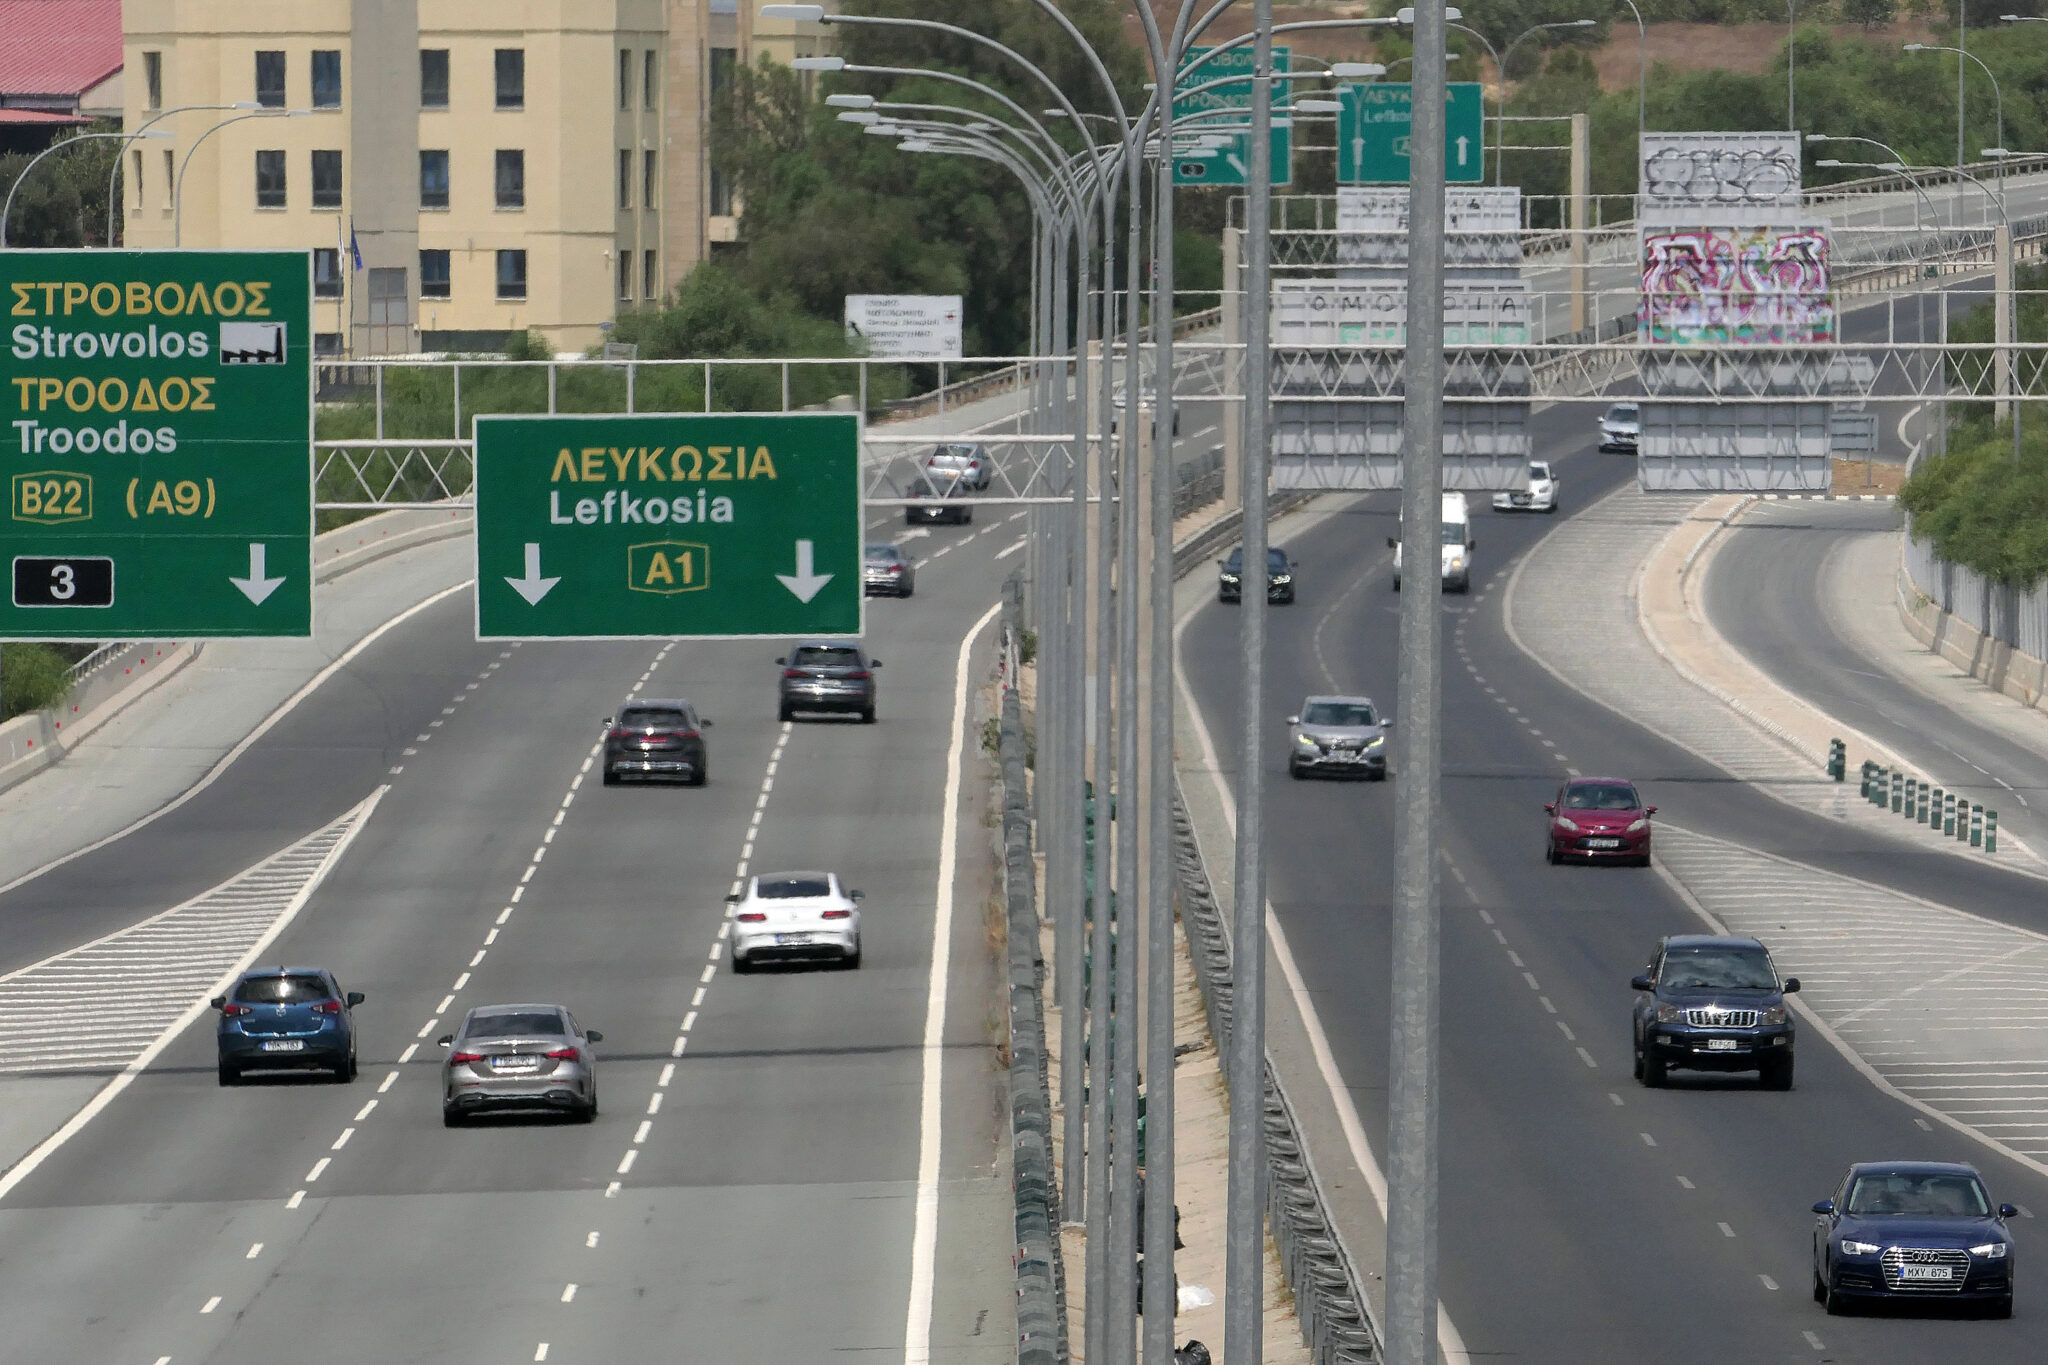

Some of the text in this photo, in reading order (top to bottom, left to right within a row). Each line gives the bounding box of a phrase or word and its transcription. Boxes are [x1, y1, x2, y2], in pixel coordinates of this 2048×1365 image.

[11, 281, 271, 316] ΣΤΡΟΒΟΛΟΣ
[11, 324, 209, 360] Strovolos
[11, 377, 216, 412] ΤΡΟΟΔΟΣ
[12, 420, 178, 454] Troodos
[551, 446, 778, 483] ΛΕΥΚΩΣΙΑ
[21, 477, 216, 519] B22 (A9)
[550, 488, 735, 525] Lefkosia
[50, 564, 76, 599] 3
[645, 551, 694, 585] A1
[1907, 1267, 1948, 1278] MXY 875
